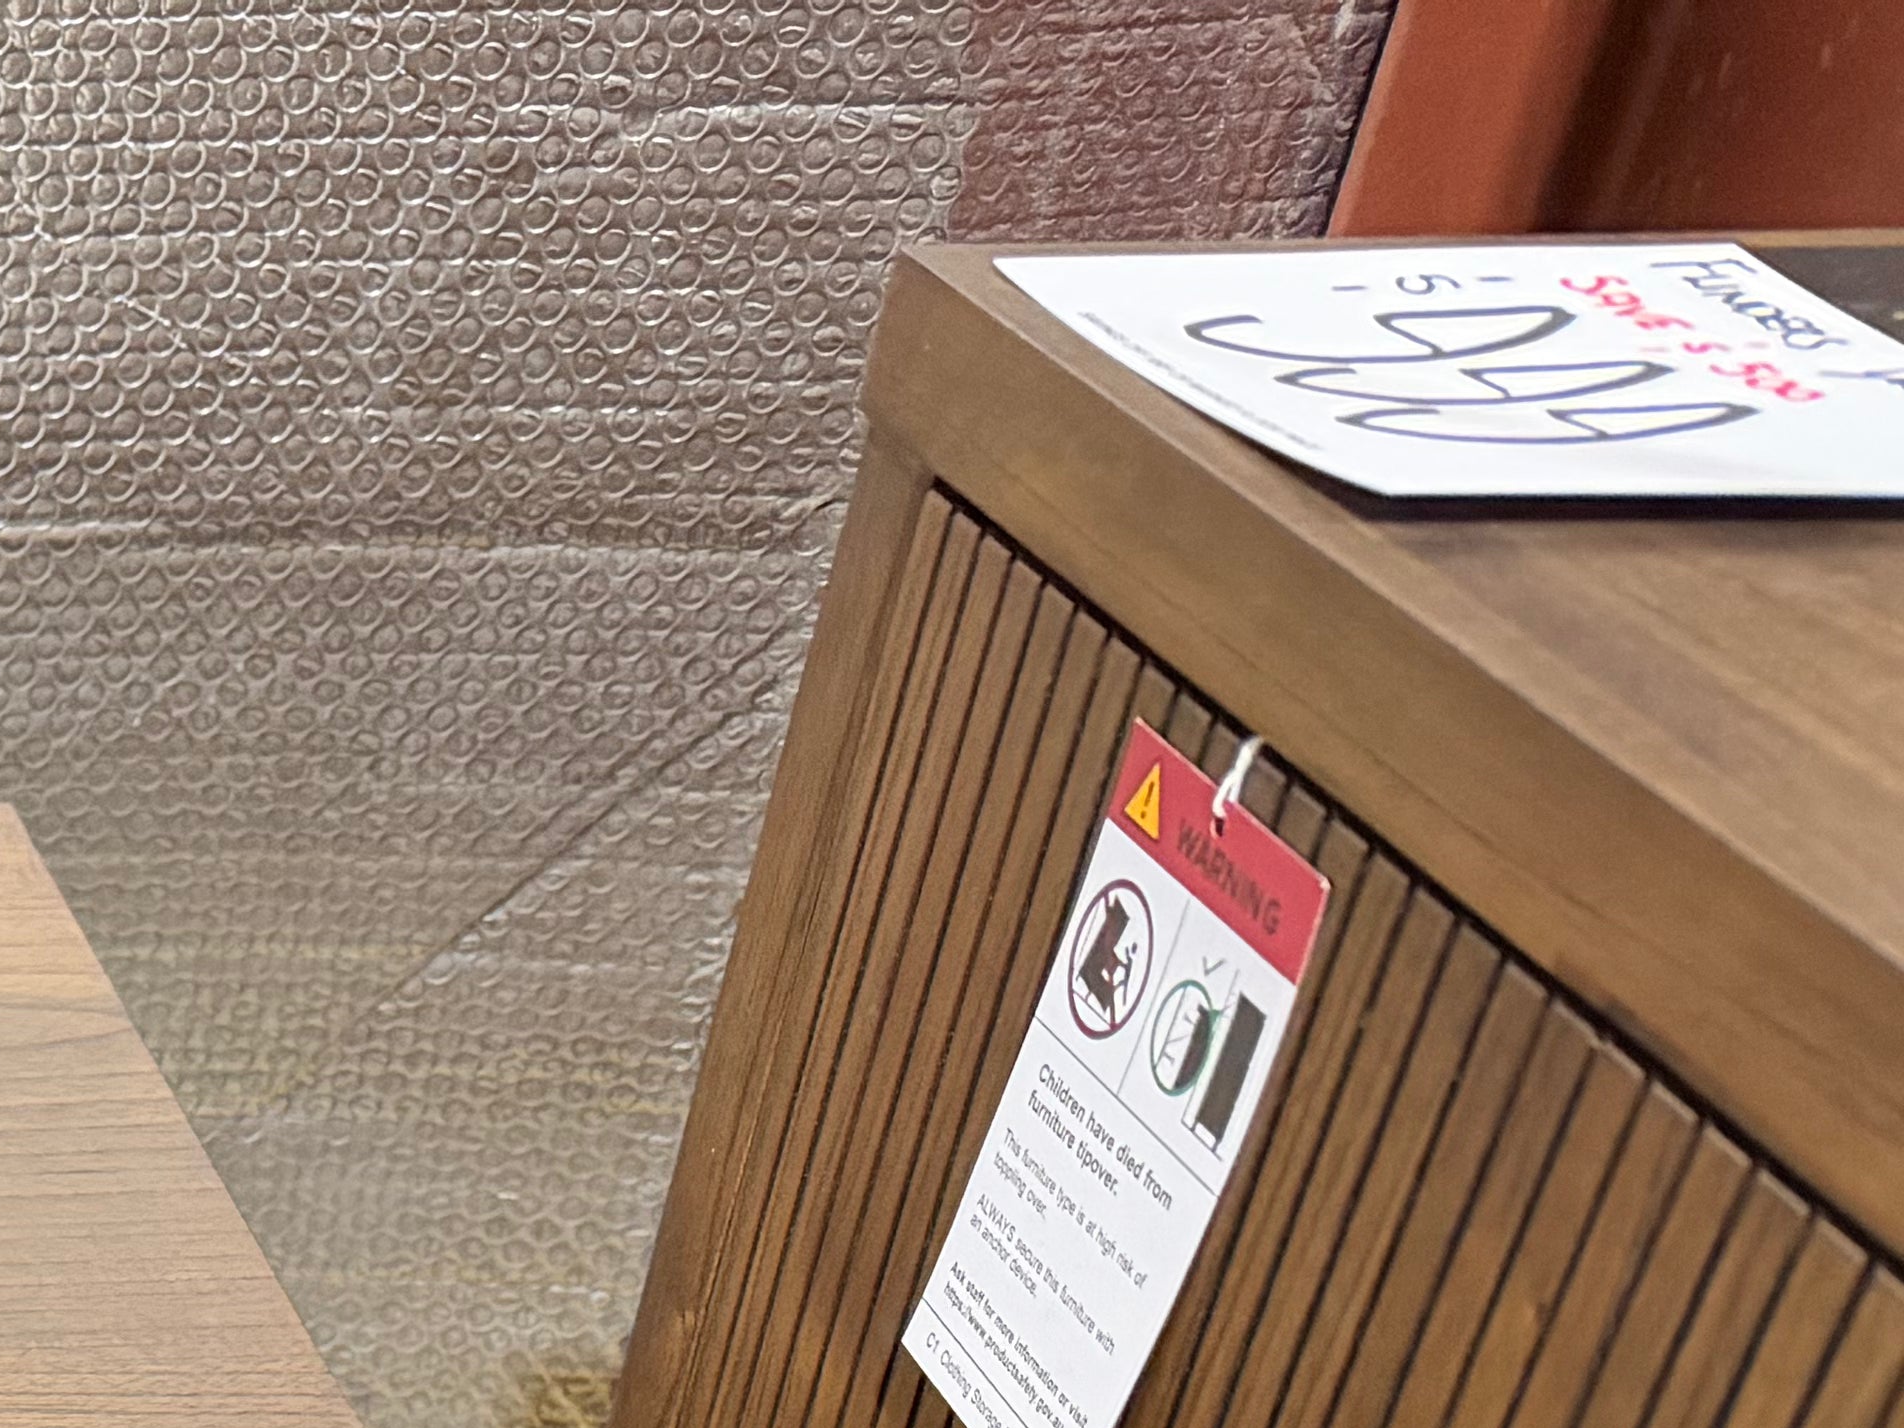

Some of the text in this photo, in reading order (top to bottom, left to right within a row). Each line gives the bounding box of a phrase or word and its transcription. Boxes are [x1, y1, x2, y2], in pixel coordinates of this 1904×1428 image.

[1559, 275, 1695, 331] SAVE
[1178, 822, 1281, 934] WARNING
[992, 1150, 1047, 1219] toppling over.
[1027, 1088, 1118, 1196] furniture tipover.
[1038, 1062, 1173, 1211] Children have died from
[968, 1212, 1037, 1298] an anchor device.
[1003, 1126, 1148, 1289] This furniture type is at high risk of
[975, 1192, 1115, 1356] ALWAYS secure this furniture with
[925, 1330, 940, 1353] C1
[939, 1348, 972, 1399] Clothing
[949, 1260, 966, 1286] Ask
[964, 1279, 985, 1307] staff
[981, 1297, 996, 1319] for
[992, 1314, 1015, 1344] more
[1013, 1336, 1059, 1397] information
[1057, 1391, 1070, 1408] or
